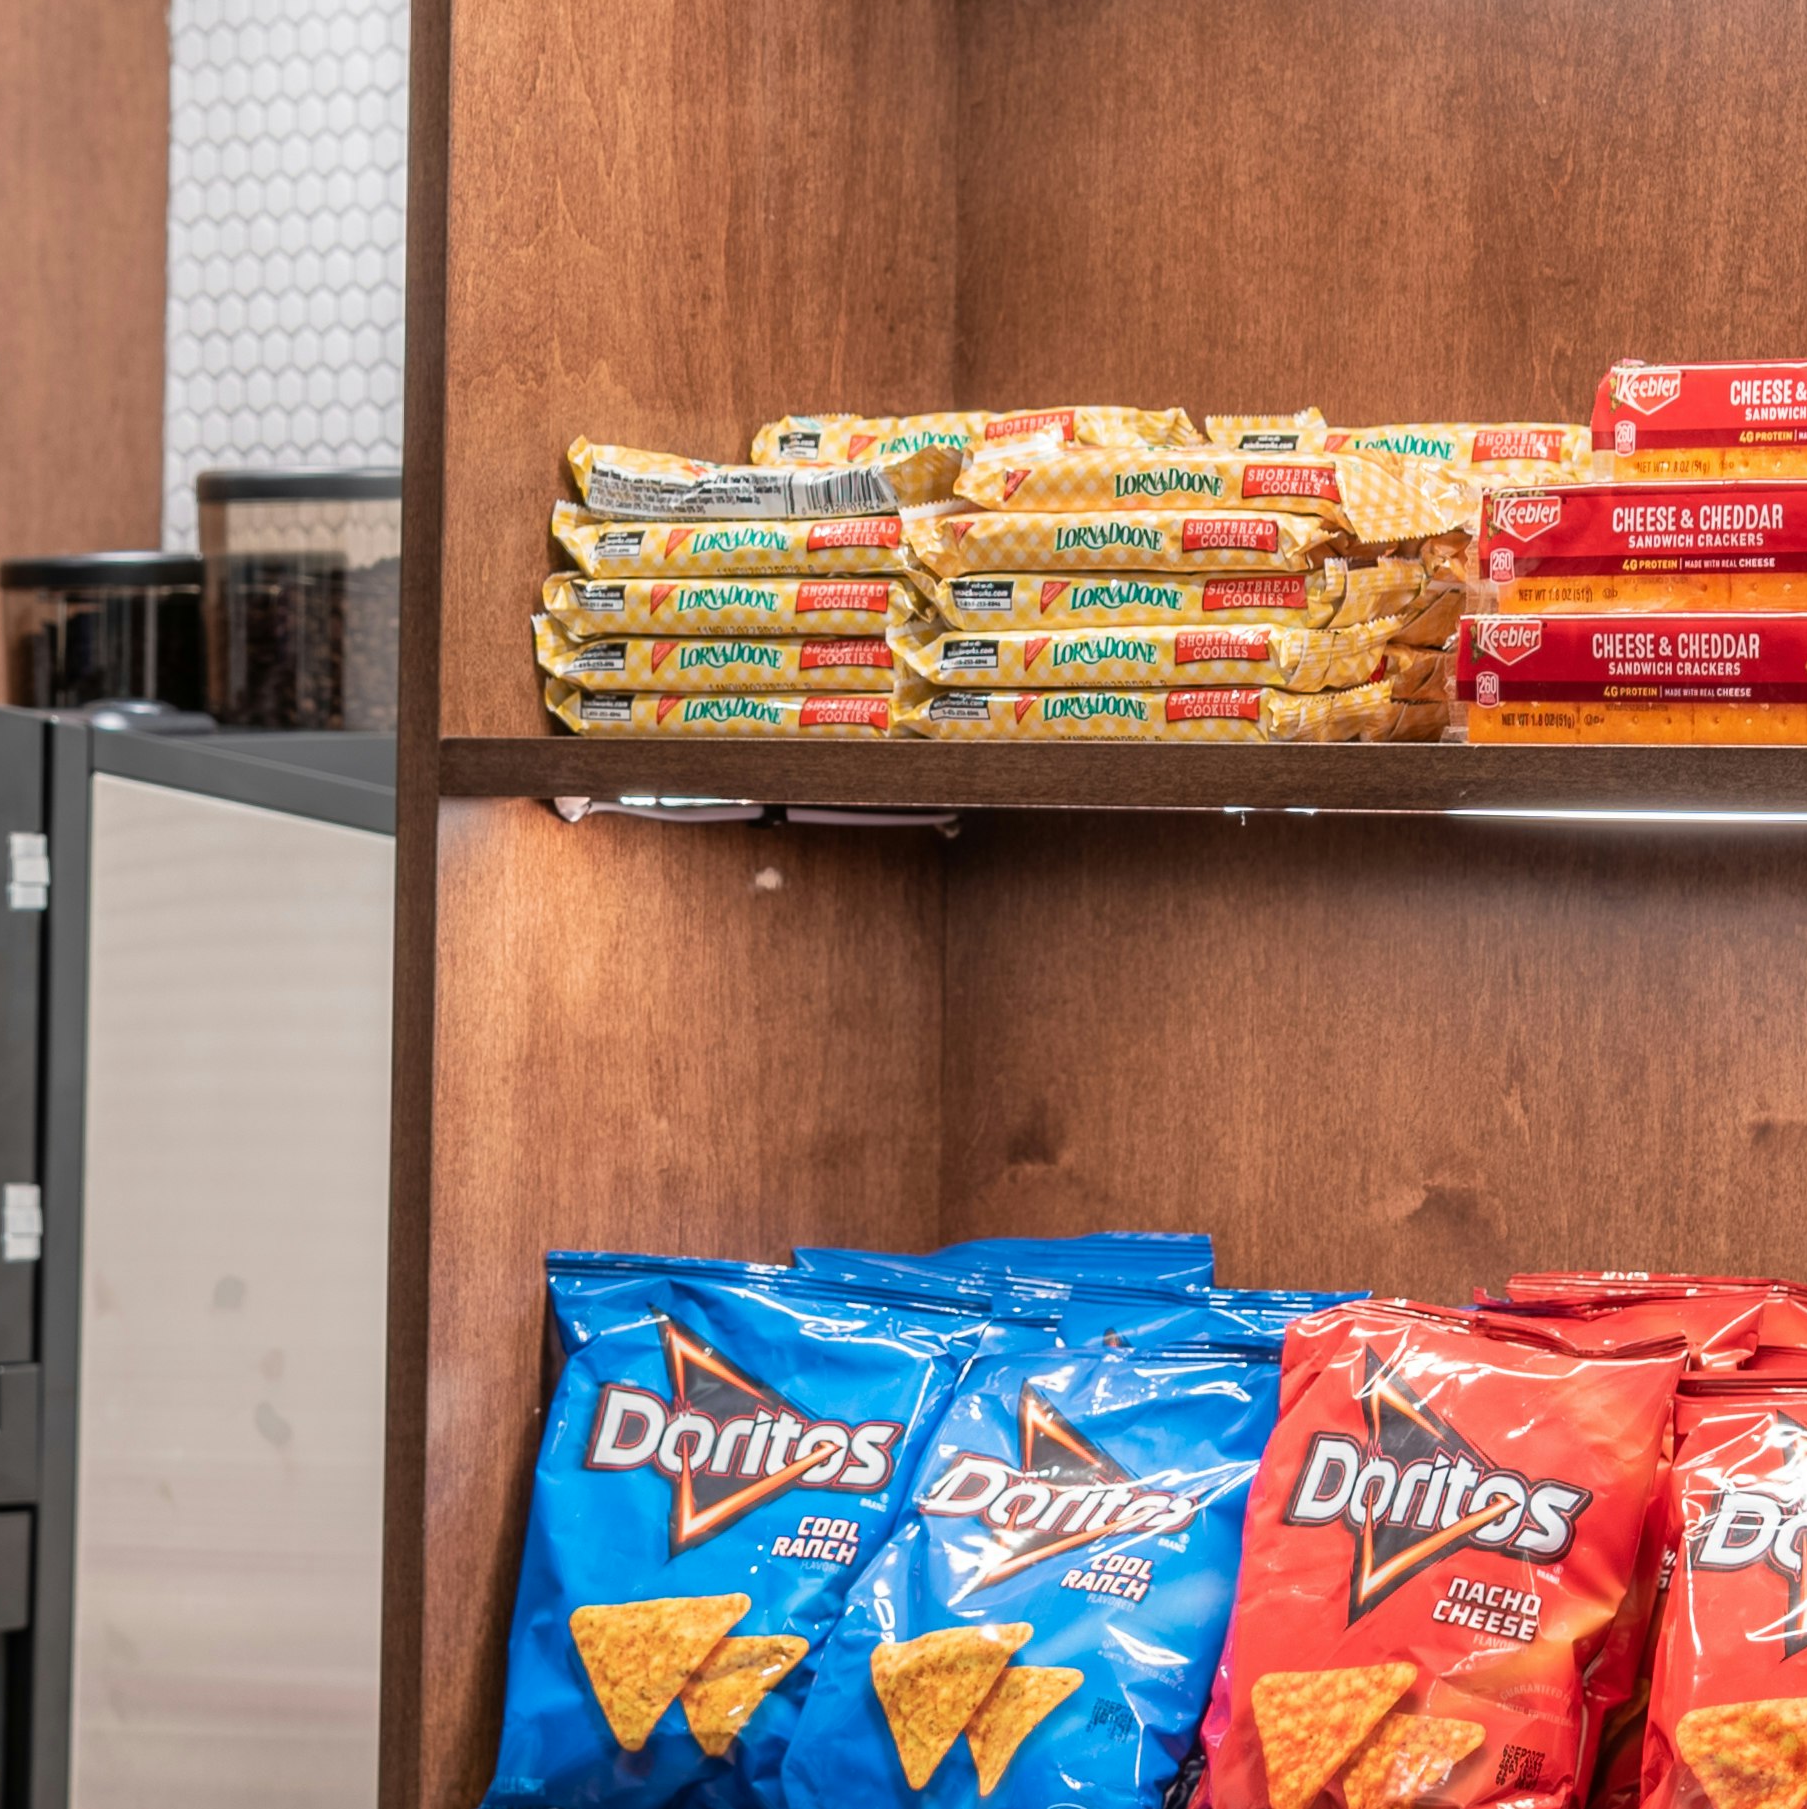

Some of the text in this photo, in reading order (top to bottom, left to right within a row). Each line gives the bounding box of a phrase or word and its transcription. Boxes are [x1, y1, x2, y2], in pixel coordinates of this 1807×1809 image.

[1618, 371, 1679, 399] Keebler
[1730, 379, 1793, 406] CHEESE
[1796, 384, 1807, 402] &
[1745, 406, 1807, 421] SANDWICH
[1496, 497, 1560, 526] Keebler
[1612, 504, 1783, 533] CHEESE & CHEDDAR
[1187, 521, 1274, 537] SHORTBREAD
[1200, 533, 1257, 547] COOKIES
[1628, 532, 1764, 549] SANDWICH CRACKERS
[1492, 552, 1512, 570] 260
[802, 585, 884, 598] SHORTBREAD
[1208, 580, 1300, 596] SHORTBREAD
[1223, 591, 1284, 606] COOKIES
[813, 596, 870, 609] COOKIES
[1479, 620, 1539, 651] Keebler
[1592, 633, 1760, 659] CHEESE & CHEDDAR
[1608, 661, 1741, 676] SANDWICH CRACKERS
[1477, 675, 1497, 694] 260
[1603, 686, 1618, 698] 4G
[1619, 687, 1658, 697] PROTEIN
[1665, 688, 1682, 697] MADE
[1716, 687, 1752, 697] CHEESE
[594, 1389, 894, 1492] Doritos
[924, 1454, 1198, 1536] Doritos
[1297, 1442, 1578, 1557] Doritos
[797, 1516, 860, 1543] COOL
[771, 1537, 857, 1566] RANCH
[1091, 1553, 1153, 1580] COOL
[1061, 1570, 1149, 1602] RANCH
[1448, 1577, 1542, 1616] NACHO
[1433, 1600, 1537, 1641] CHEESE
